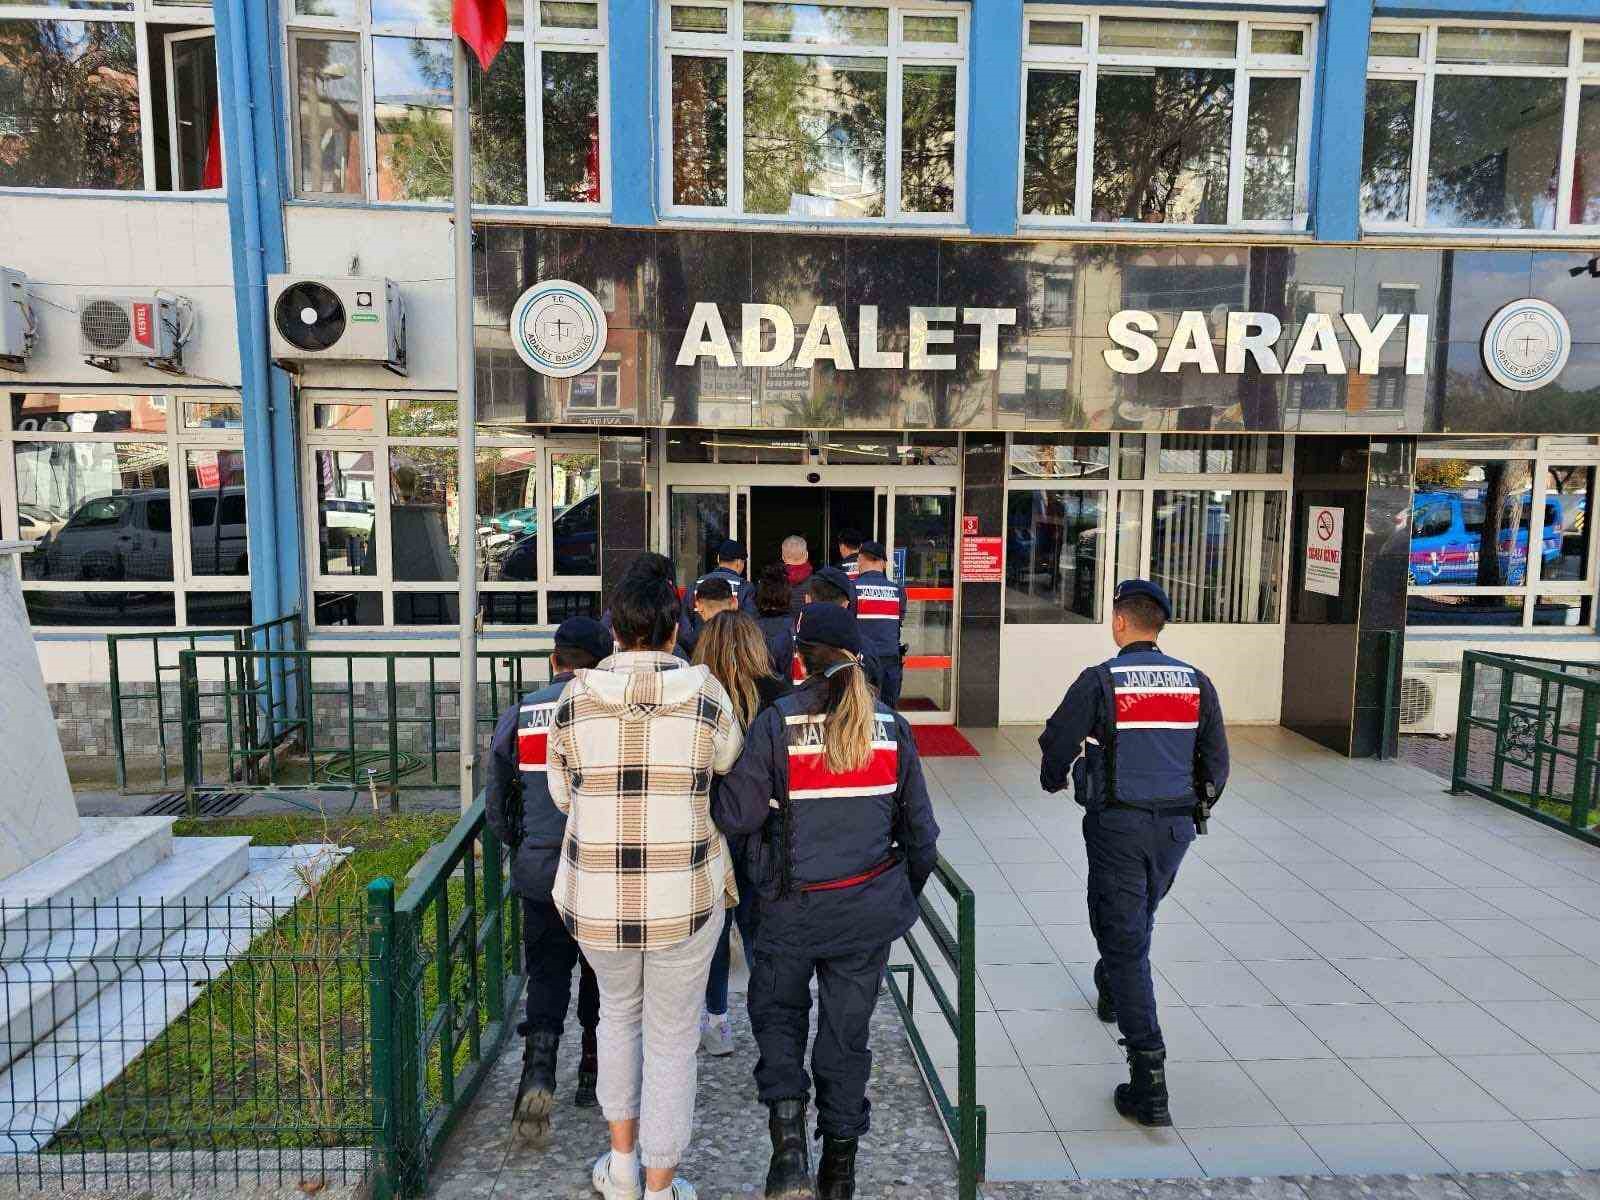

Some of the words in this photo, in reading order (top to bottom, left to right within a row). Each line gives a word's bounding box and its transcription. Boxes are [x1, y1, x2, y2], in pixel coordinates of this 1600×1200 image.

[138, 307, 147, 336] VESTEL
[527, 333, 554, 360] ADALET
[675, 302, 1017, 371] ADALET
[1103, 310, 1428, 374] SARAYI
[1497, 348, 1520, 374] ADALET
[967, 520, 974, 530] 3
[1123, 671, 1193, 688] JANDARMA
[528, 709, 554, 728] JAN
